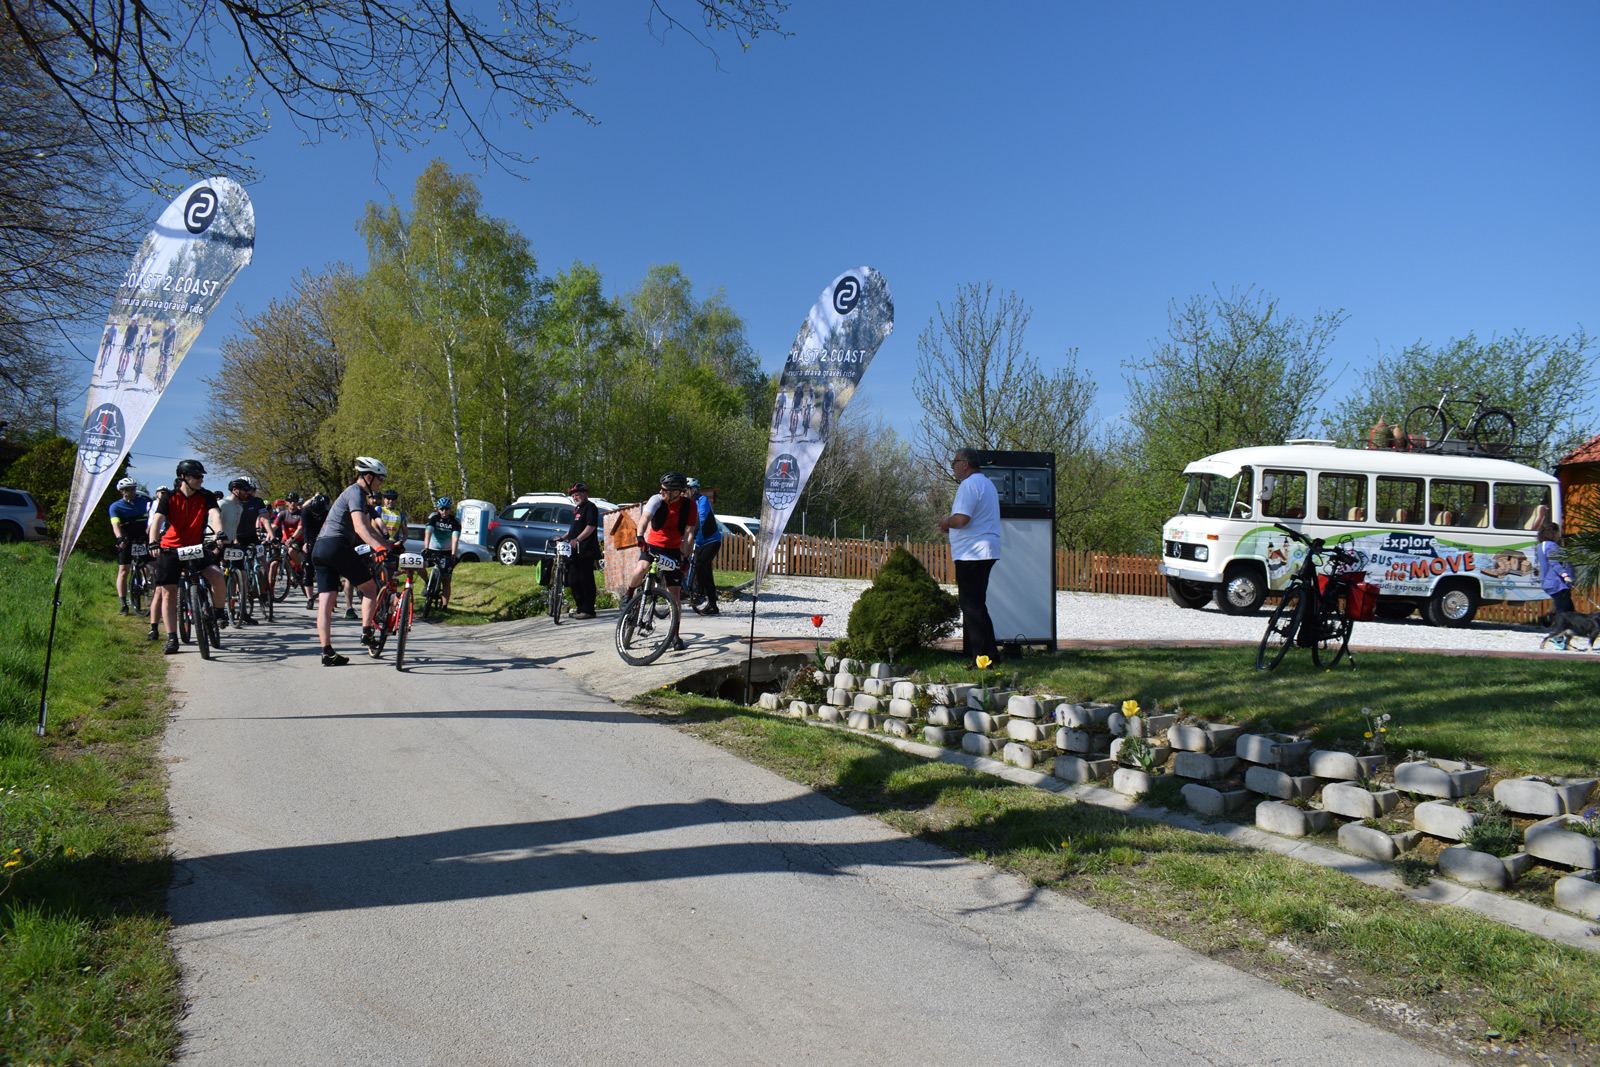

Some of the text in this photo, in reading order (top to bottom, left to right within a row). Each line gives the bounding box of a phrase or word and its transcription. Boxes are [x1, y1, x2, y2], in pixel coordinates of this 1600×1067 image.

[163, 275, 173, 291] 2
[175, 276, 219, 297] COAST
[121, 297, 140, 306] mura
[141, 297, 163, 309] drava
[163, 301, 189, 312] gravel
[820, 349, 828, 362] 2
[830, 349, 866, 364] COAST
[804, 368, 821, 376] drava
[823, 369, 842, 378] gravel
[1383, 535, 1438, 550] Explore
[181, 546, 202, 556] 125
[225, 550, 243, 558] 113
[400, 556, 422, 565] 135
[1370, 553, 1393, 567] BUS
[1392, 561, 1409, 572] on
[1409, 552, 1476, 580] MOVE
[1385, 569, 1407, 581] the
